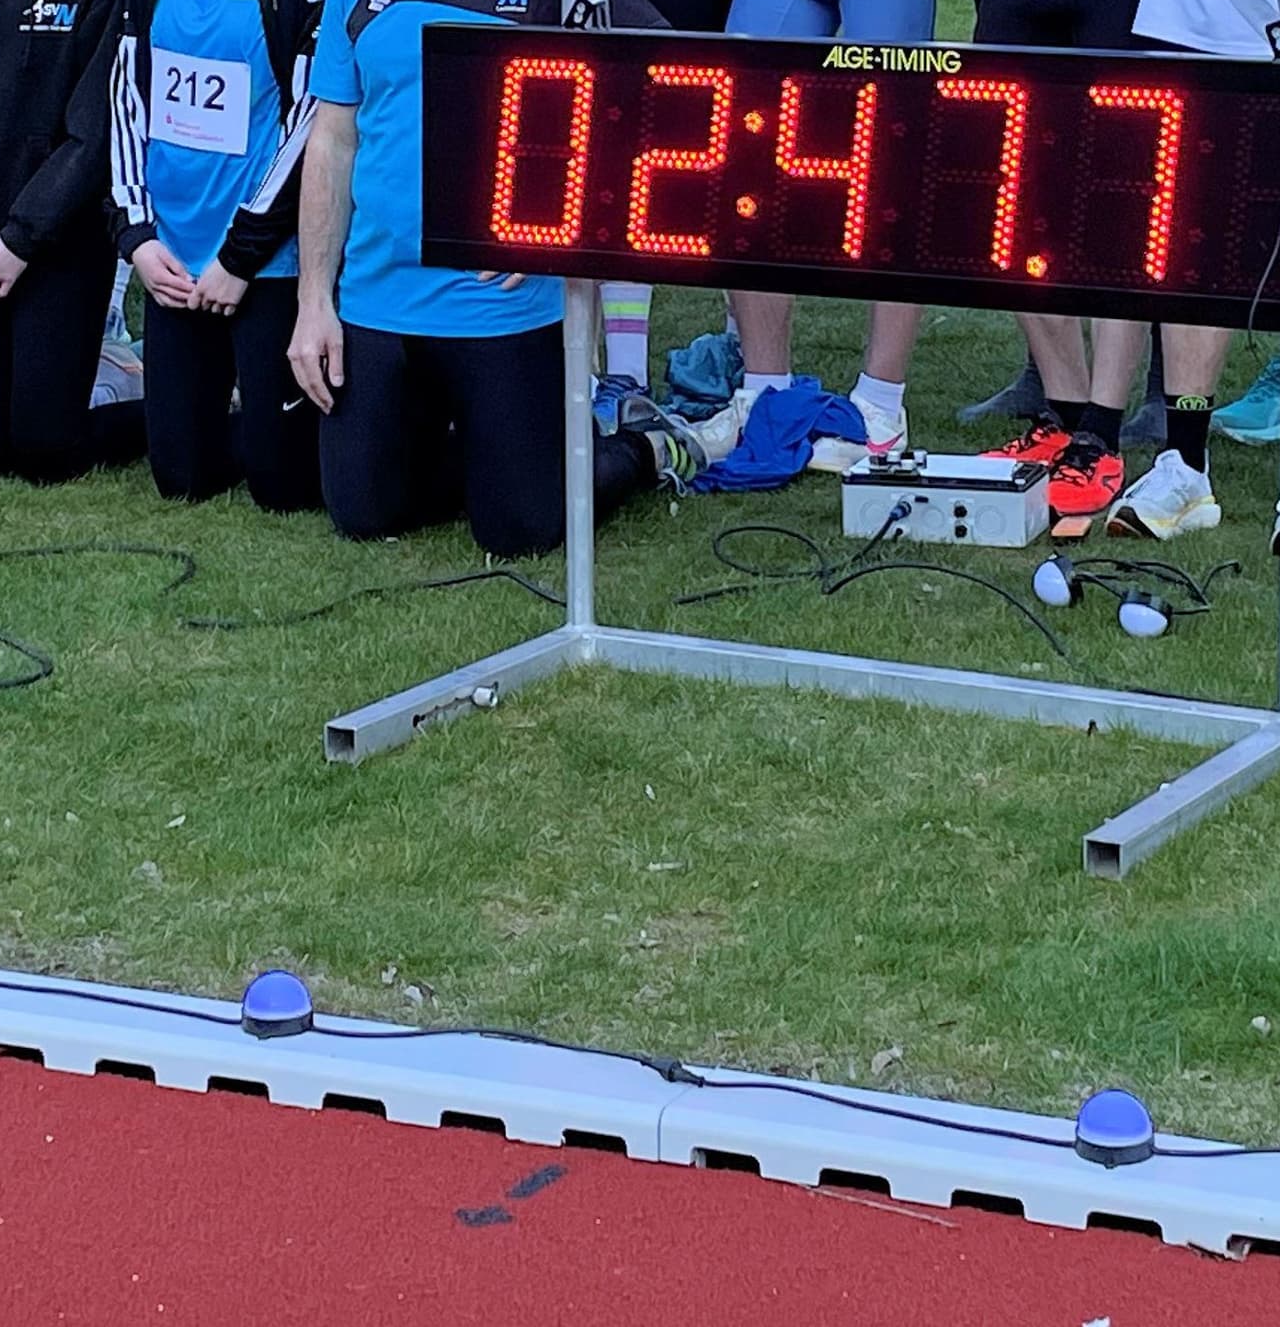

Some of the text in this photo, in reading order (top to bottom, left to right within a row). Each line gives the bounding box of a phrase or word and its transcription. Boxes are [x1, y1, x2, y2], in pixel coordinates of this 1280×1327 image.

[822, 45, 962, 74] ALGE-TIMING
[165, 66, 226, 112] 212
[489, 56, 1186, 283] 02:47.7
